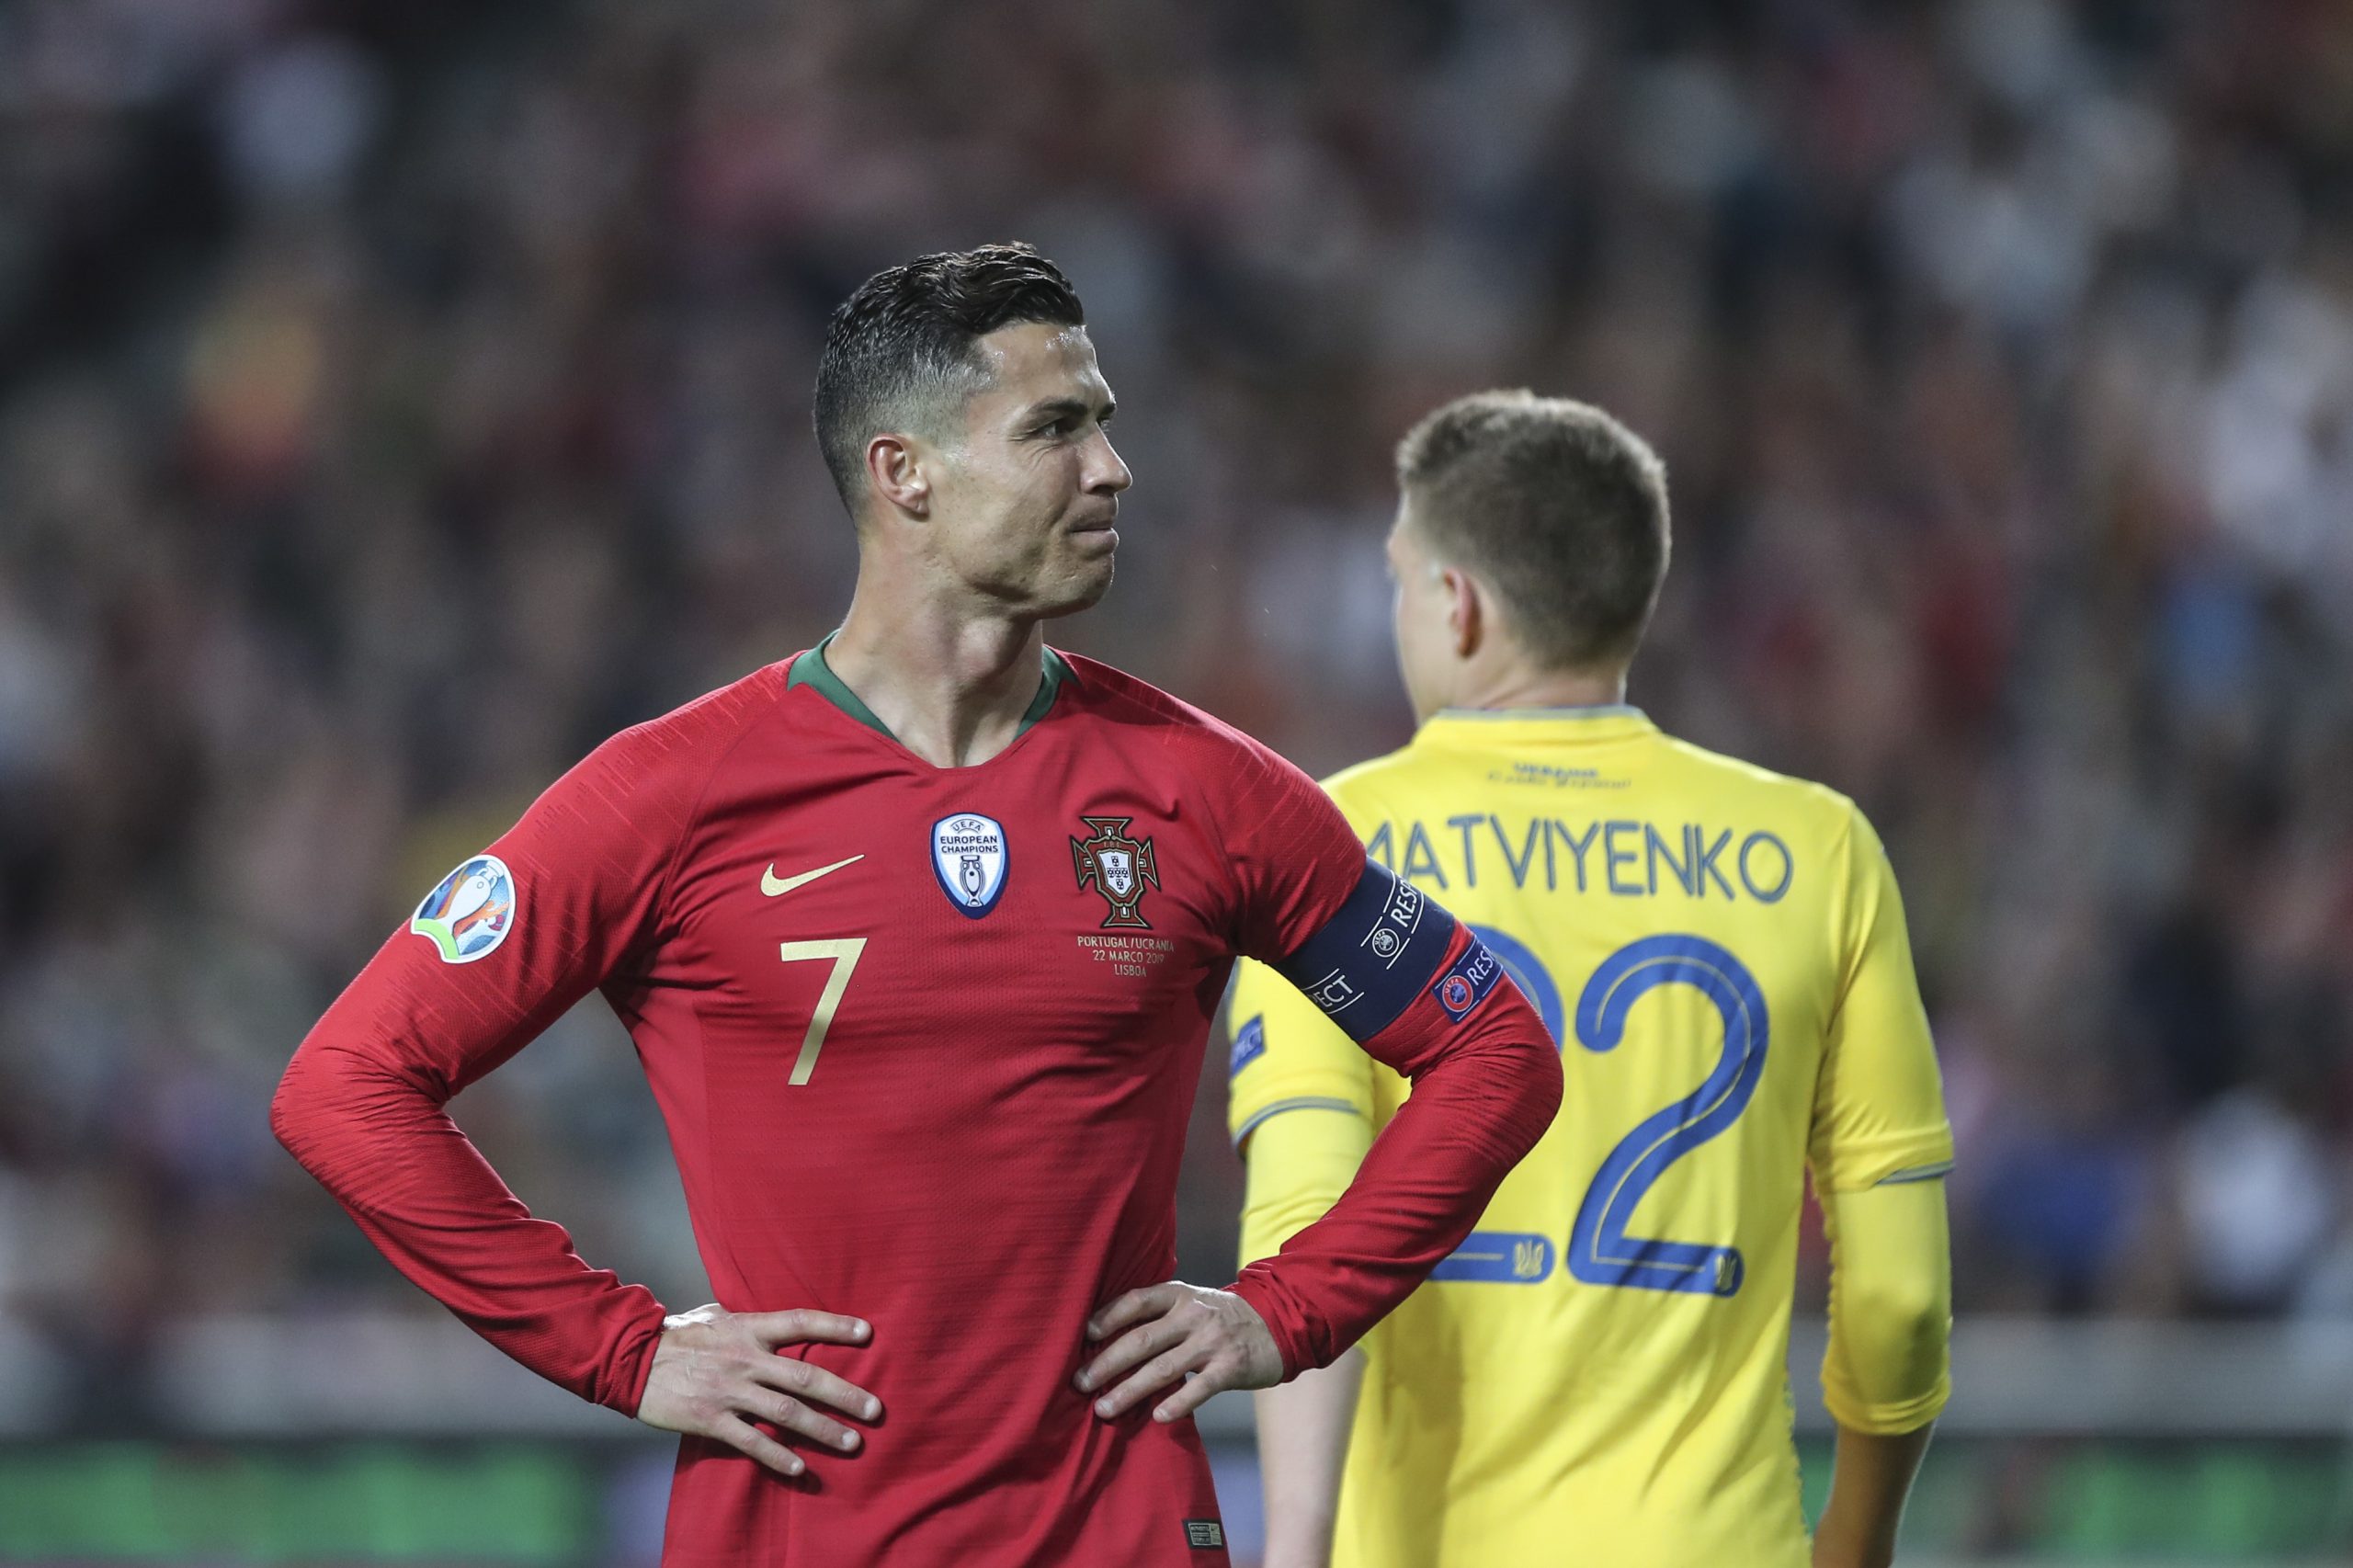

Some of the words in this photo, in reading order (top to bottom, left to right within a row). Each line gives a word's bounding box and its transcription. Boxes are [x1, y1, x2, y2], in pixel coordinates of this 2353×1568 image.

[952, 821, 981, 831] UEFA
[940, 835, 997, 845] EUROPEAN
[941, 846, 999, 854] CHAMPIONS
[1374, 930, 1386, 946] UEFA
[1092, 949, 1106, 961] 22
[1146, 952, 1165, 964] 2019
[1114, 963, 1147, 977] LISBOA
[1307, 974, 1353, 1007] ECT
[1445, 978, 1460, 994] UEFA
[780, 937, 868, 1085] 7
